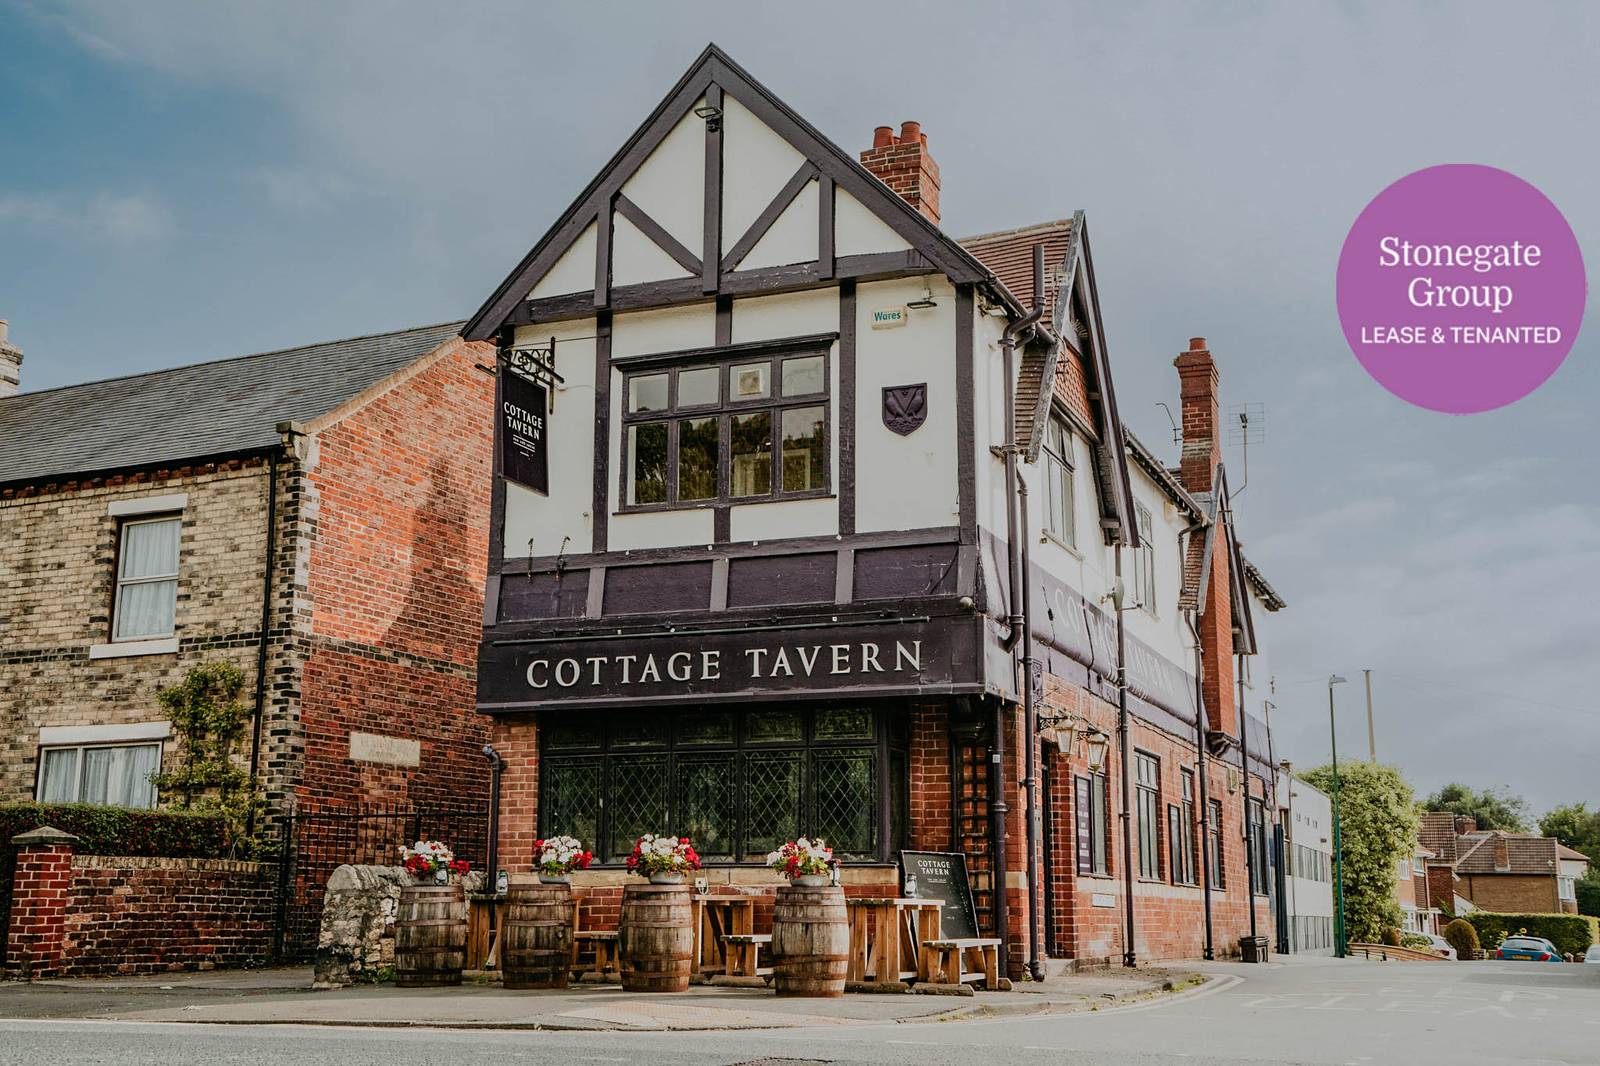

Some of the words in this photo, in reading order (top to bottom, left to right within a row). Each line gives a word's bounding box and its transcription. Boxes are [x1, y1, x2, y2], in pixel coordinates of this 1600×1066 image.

[874, 311, 901, 321] Wares
[503, 401, 543, 429] COTTAGE
[506, 415, 540, 440] TAVERN
[526, 651, 721, 688] COTTAGE
[745, 641, 922, 678] TAVERN
[917, 860, 950, 868] COTTAGE
